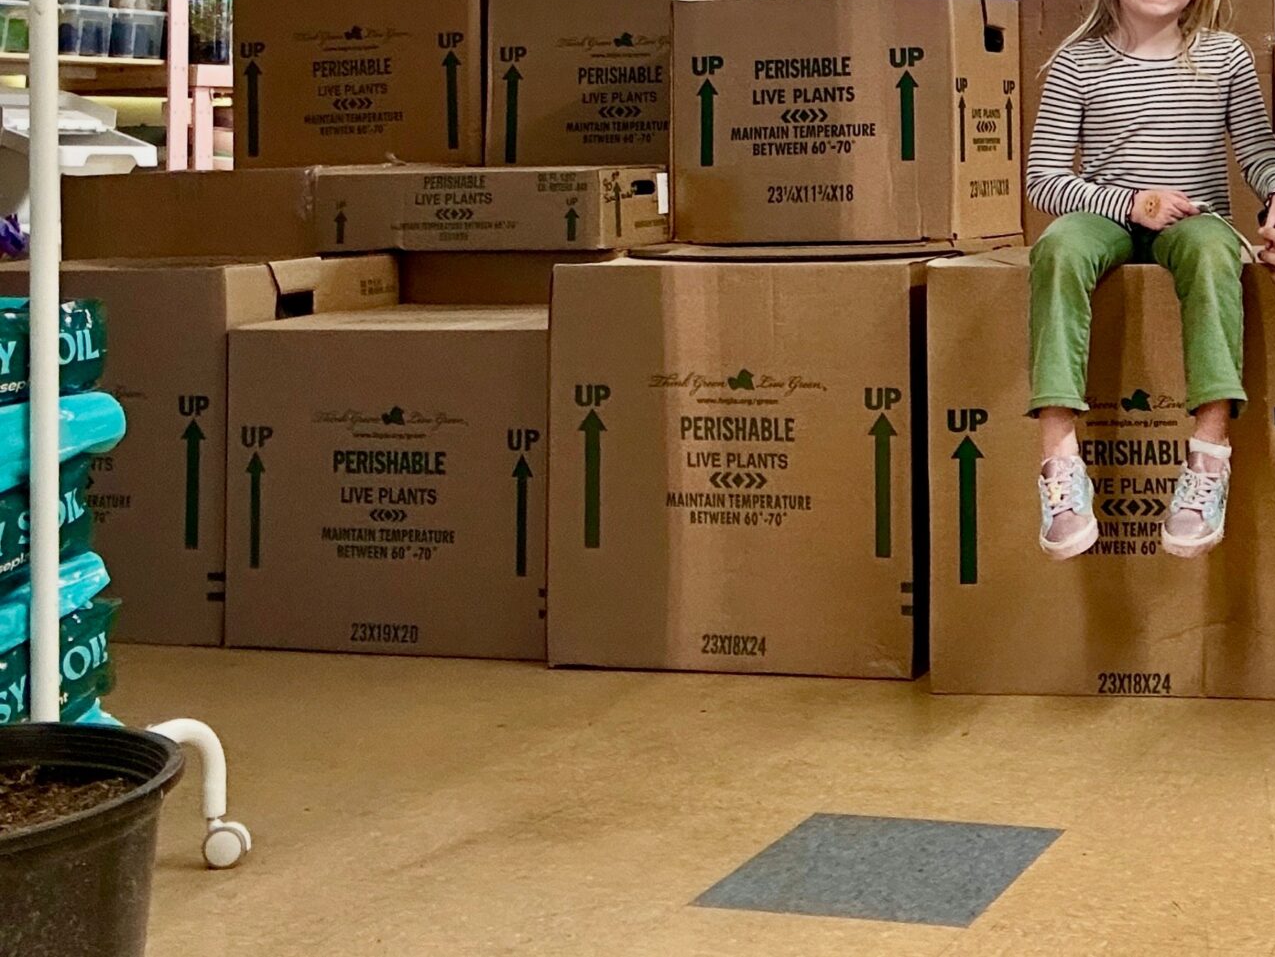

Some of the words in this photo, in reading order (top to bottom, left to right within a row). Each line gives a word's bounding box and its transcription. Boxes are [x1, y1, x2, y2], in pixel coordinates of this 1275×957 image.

[437, 32, 464, 49] UP
[240, 42, 265, 59] UP
[500, 46, 527, 62] UP
[889, 47, 924, 68] UP
[312, 58, 392, 78] PERISHABLE
[578, 66, 663, 84] PERISHABLE
[691, 56, 724, 76] UP
[754, 57, 852, 80] PERISHABLE
[317, 84, 341, 96] LIVE
[344, 83, 388, 95] PLANTS
[956, 78, 968, 93] UP
[1003, 80, 1015, 94] UP
[582, 93, 607, 104] LIVE
[611, 91, 657, 104] PLANTS
[752, 89, 785, 105] LIVE
[793, 86, 855, 104] PLANTS
[346, 111, 404, 123] TEMPERATURE
[566, 122, 611, 132] MAINTAIN
[612, 121, 670, 132] TEMPERATUR
[731, 126, 790, 141] MAINTAIN
[792, 123, 876, 138] TEMPERATURE
[752, 141, 808, 156] BETWEEN
[423, 175, 486, 190] PERISHABLE
[415, 193, 441, 205] LIVE
[444, 192, 493, 205] PLANTS
[566, 197, 578, 207] UP
[59, 329, 100, 365] OIL
[575, 384, 611, 407] UP
[864, 387, 902, 410] UP
[178, 396, 209, 416] UP
[681, 416, 795, 442] PERISHABLE
[947, 409, 988, 434] UP
[241, 426, 273, 447] UP
[507, 429, 540, 451] UP
[687, 452, 721, 468] LIVE
[727, 453, 788, 469] PLANTS
[1079, 440, 1190, 466] ERISHABL
[333, 450, 446, 475] PERISHABLE
[1120, 478, 1178, 494] PLANT
[340, 487, 374, 504] LIVE
[378, 487, 437, 505] PLANTS
[666, 494, 725, 509] MAINTAIN
[728, 494, 811, 510] TEMPERATURE
[690, 511, 740, 525] BETWEEN
[321, 527, 376, 542] MAINTAIN
[379, 529, 455, 544] TEMPERATURE
[337, 545, 388, 559] BETWEEN
[350, 623, 419, 644] 23X19X20
[701, 633, 767, 657] 23X18X24
[1098, 672, 1172, 694] 23X18X24
